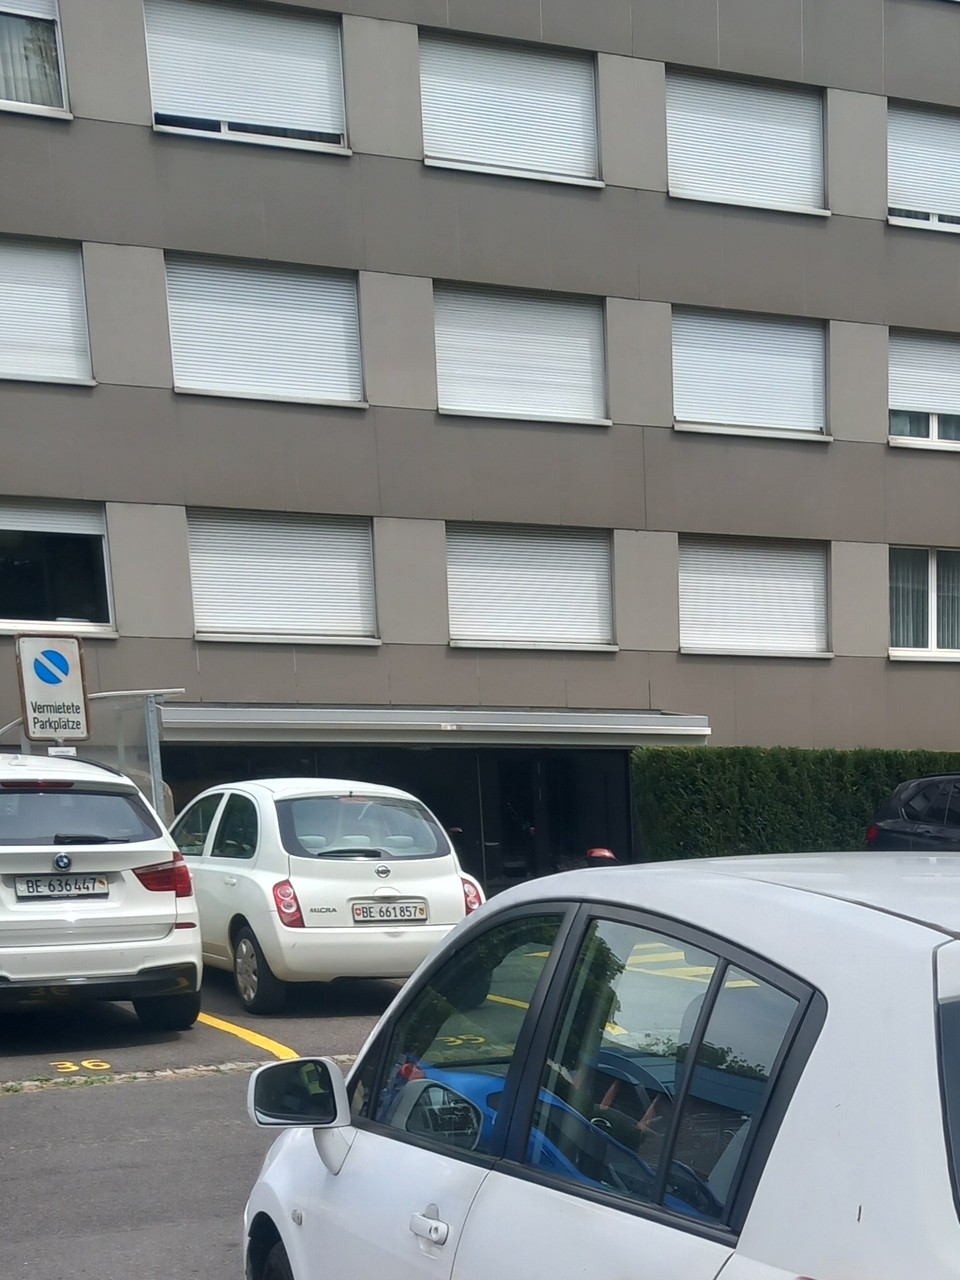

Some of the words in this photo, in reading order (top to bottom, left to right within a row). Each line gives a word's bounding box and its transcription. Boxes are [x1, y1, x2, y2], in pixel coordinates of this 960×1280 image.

[30, 701, 81, 714] Vermietete
[32, 717, 81, 733] Parkplätze
[435, 1034, 486, 1046] 35
[48, 1059, 112, 1072] 36
